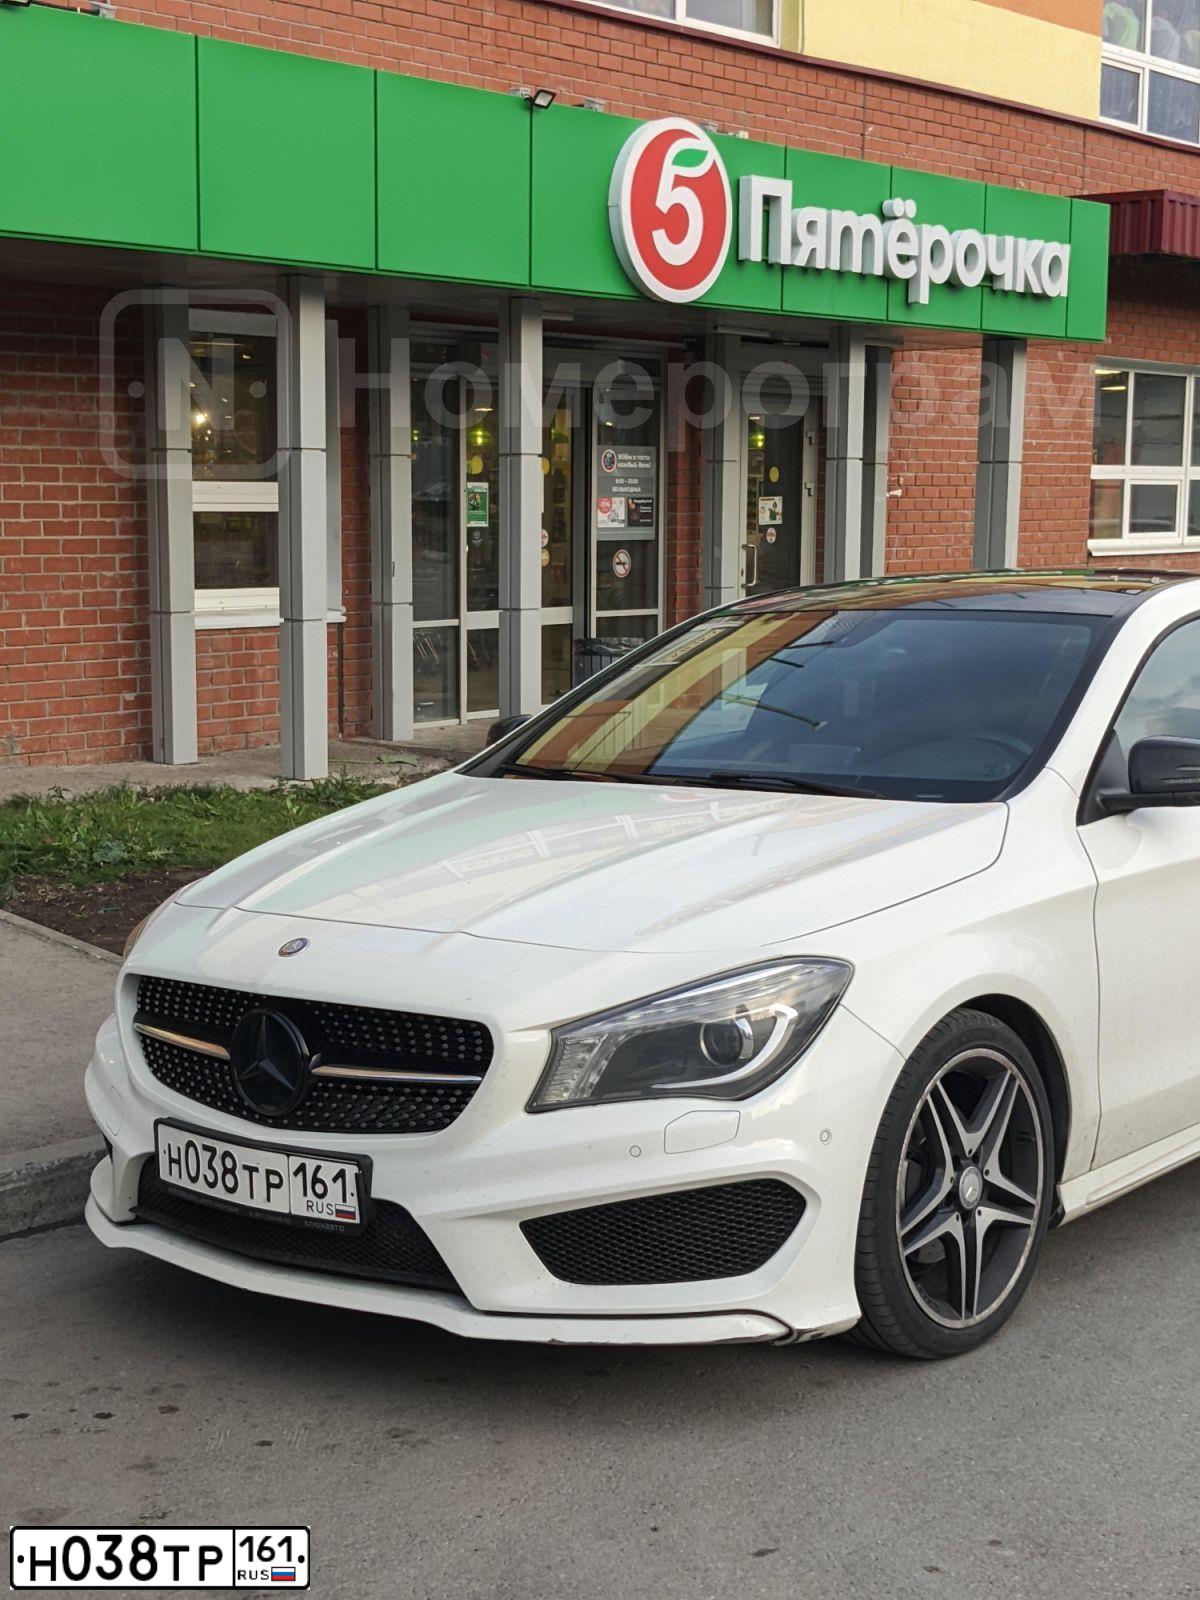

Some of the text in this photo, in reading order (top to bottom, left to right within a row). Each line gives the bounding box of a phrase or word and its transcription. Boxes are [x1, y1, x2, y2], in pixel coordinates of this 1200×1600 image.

[652, 137, 1072, 305] 5 Пятёрочка
[167, 1139, 284, 1203] Н038ТР
[293, 1162, 347, 1203] 161
[306, 1200, 334, 1216] RUS
